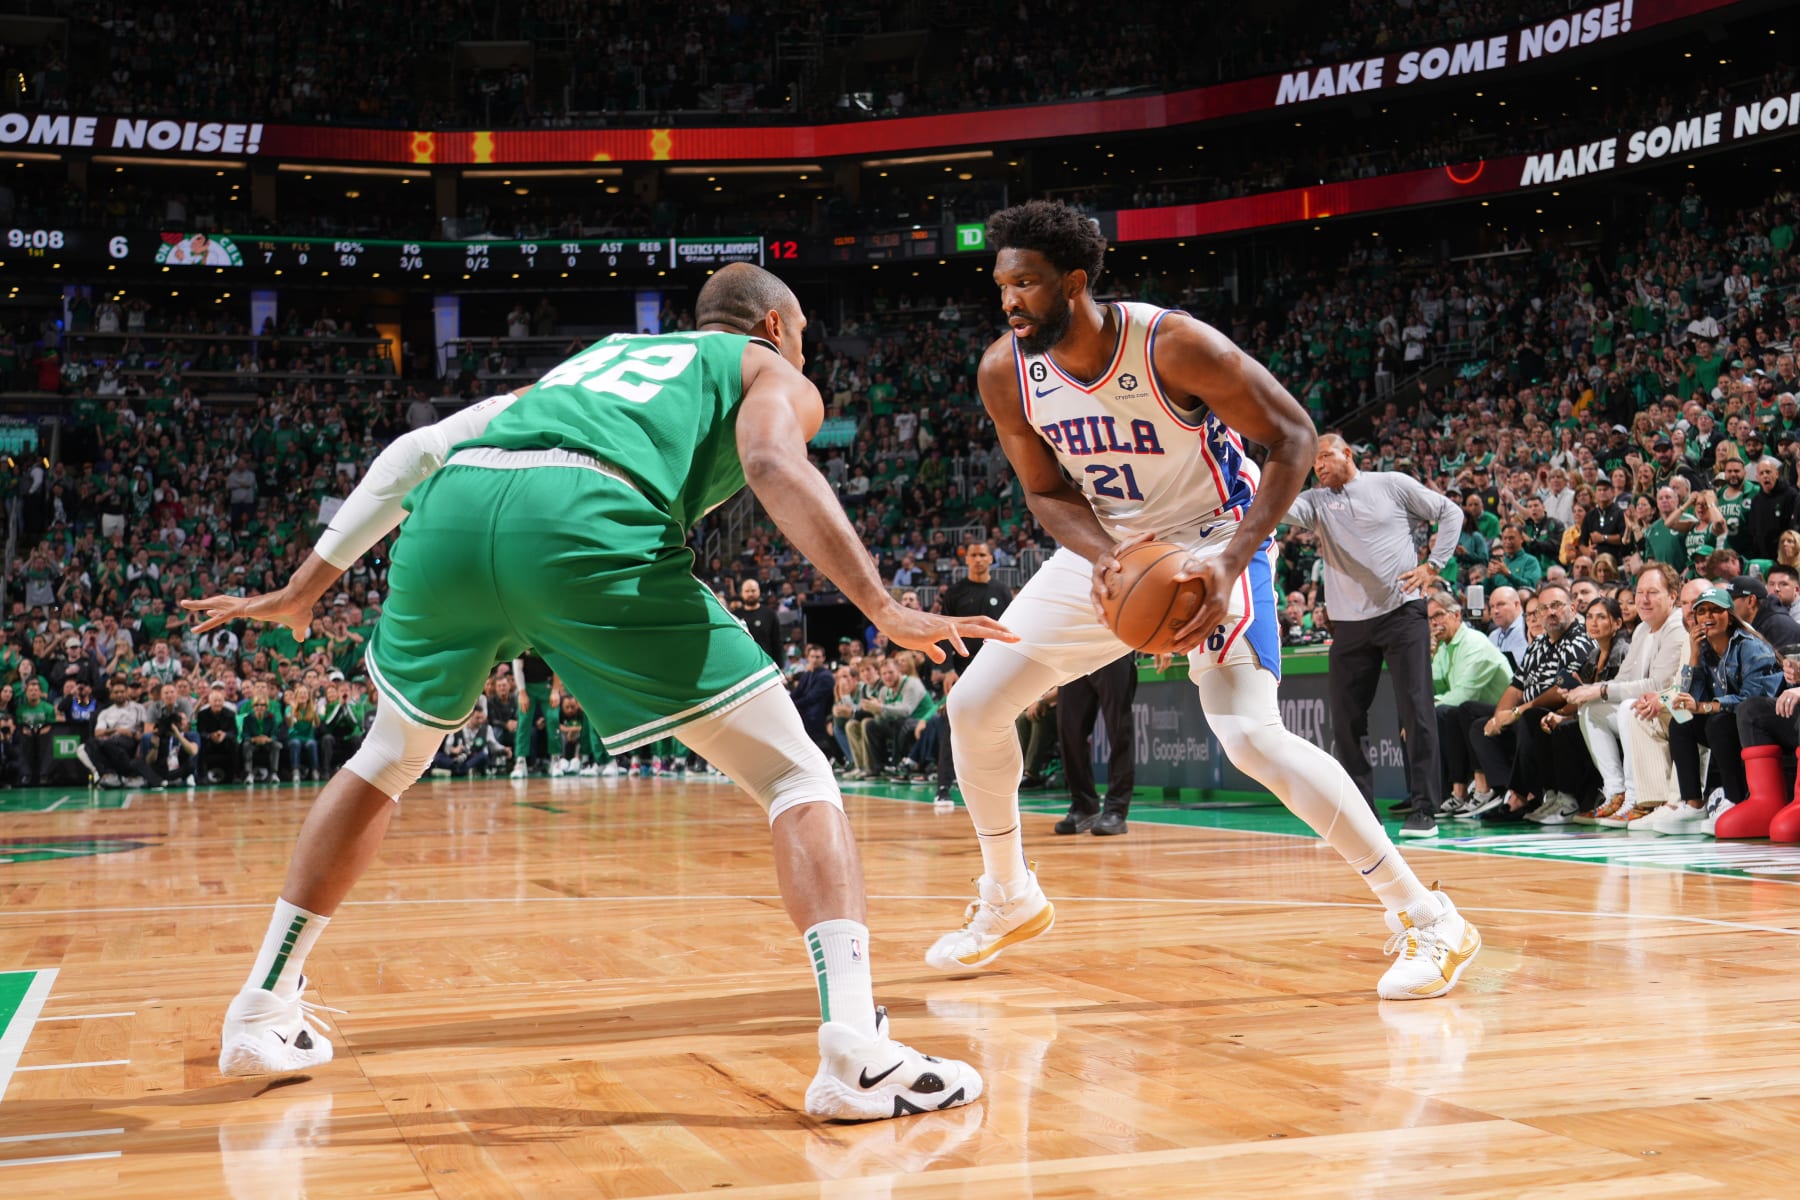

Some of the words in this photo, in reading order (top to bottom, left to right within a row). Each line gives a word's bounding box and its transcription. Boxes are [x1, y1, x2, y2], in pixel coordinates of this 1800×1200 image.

[1275, 58, 1385, 105] MAKE
[1396, 35, 1508, 84] SOME
[1518, 0, 1633, 62] NOISE!
[111, 118, 263, 154] NOISE!
[1520, 137, 1617, 187] MAKE
[1626, 112, 1722, 163] SOME
[8, 229, 65, 249] 9:08
[108, 236, 129, 259] 6
[959, 228, 983, 246] TD
[334, 241, 364, 254] FG%
[402, 244, 421, 255] FG
[466, 244, 489, 256] 3PT
[520, 243, 538, 255] TO
[561, 242, 581, 254] STL
[600, 242, 623, 253] AST
[639, 241, 661, 253] REB
[679, 244, 713, 255] CELTICS
[714, 242, 759, 255] PLAYOFFS
[769, 240, 799, 260] 12
[264, 252, 273, 264] 7
[299, 253, 307, 265] 0
[340, 255, 356, 267] 50
[400, 256, 423, 271] 3/6
[466, 257, 489, 272] 0/2
[527, 256, 534, 267] 1
[567, 255, 576, 268] 0
[608, 254, 617, 267] 0
[647, 253, 655, 266] 5
[539, 343, 698, 404] 42
[1033, 363, 1045, 380] 6
[1114, 392, 1149, 401] crypto.com
[1040, 416, 1165, 455] PHILA
[1085, 463, 1145, 502] 21
[56, 739, 77, 755] TD
[1152, 737, 1186, 766] Google
[1187, 737, 1210, 761] Pixel
[1380, 738, 1404, 767] Pix
